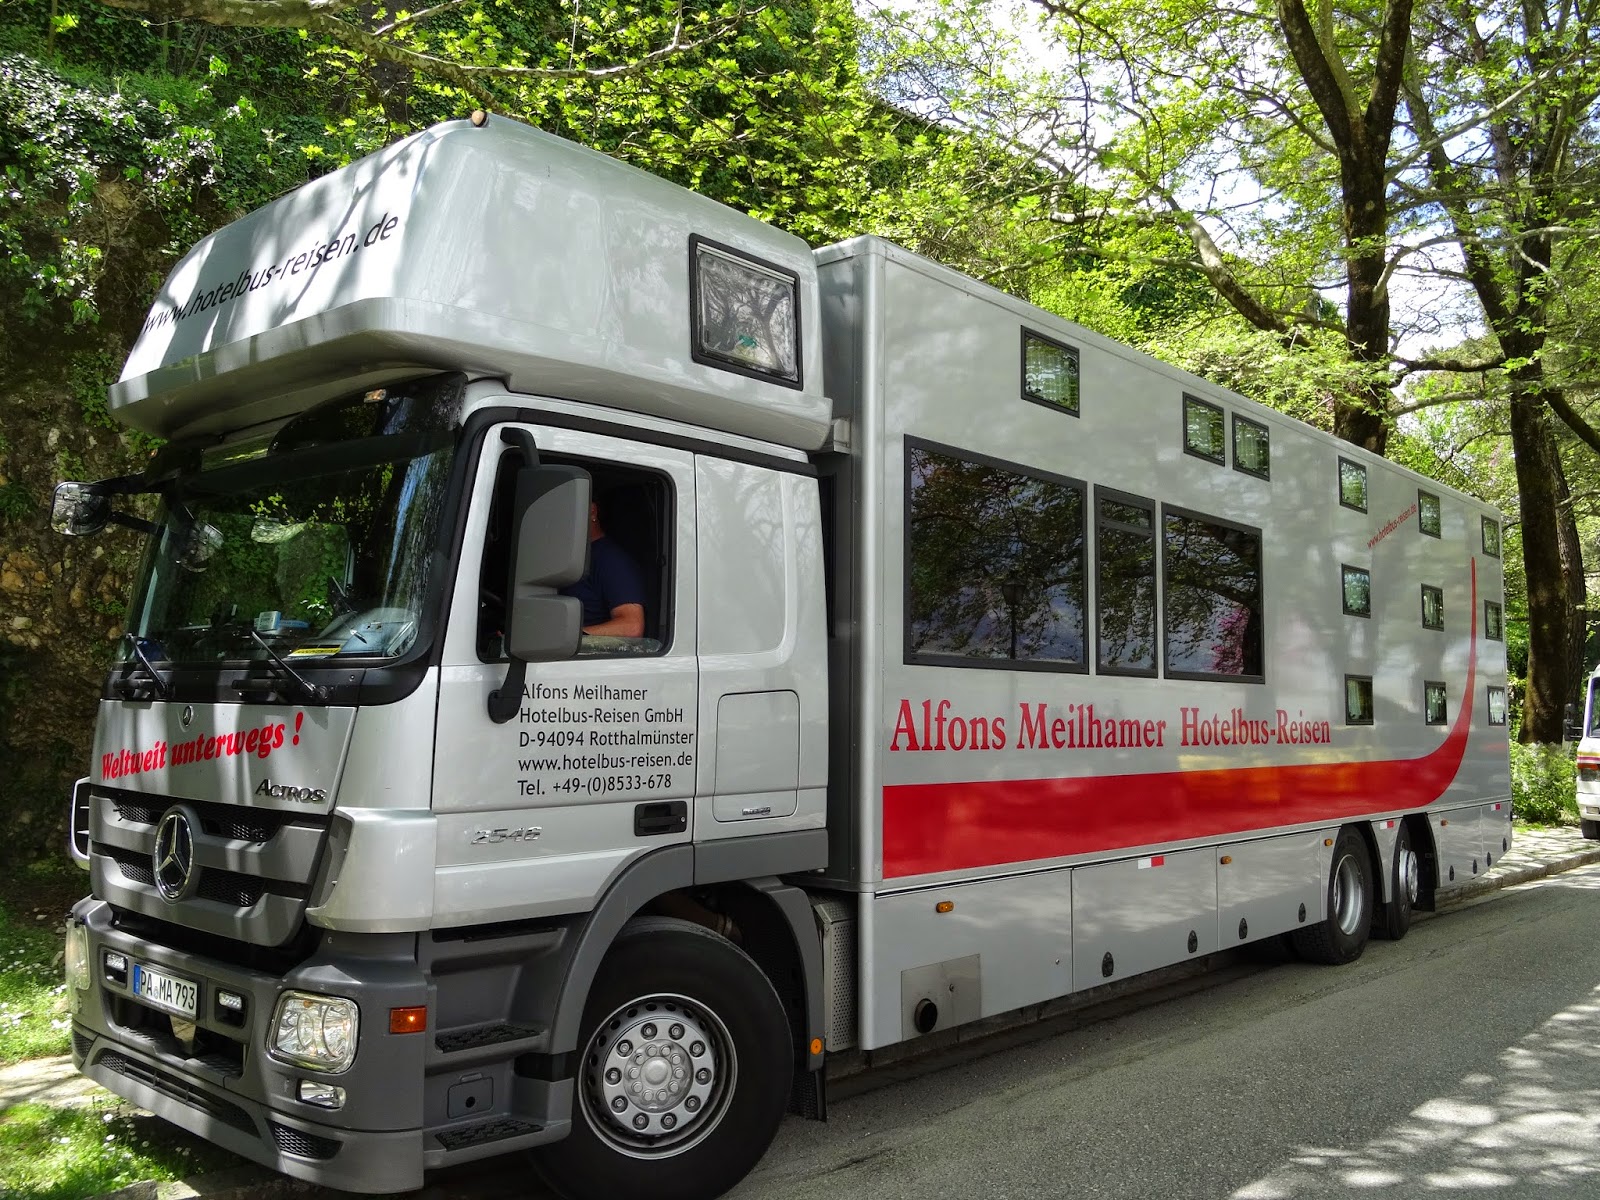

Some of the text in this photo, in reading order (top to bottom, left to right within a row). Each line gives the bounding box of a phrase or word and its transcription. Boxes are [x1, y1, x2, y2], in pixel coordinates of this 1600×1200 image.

[143, 211, 399, 334] www.hotelbus-reisen.de
[521, 683, 648, 701] Alfons Meilhamer
[519, 707, 684, 724] Hotelbus-Reisen GmbH
[889, 699, 1331, 751] Alfons Meilhamer Hotelbus-Reisen
[519, 729, 694, 748] D-94094 Rotthalmünster
[101, 740, 168, 781] Weltweit
[170, 723, 286, 767] unterwegs
[518, 751, 693, 771] www.hotelbus-reisen.de
[517, 773, 672, 796] Tel. +49-(0)8533-678
[141, 970, 153, 996] PA
[159, 976, 173, 1003] MA
[175, 981, 196, 1010] 793
